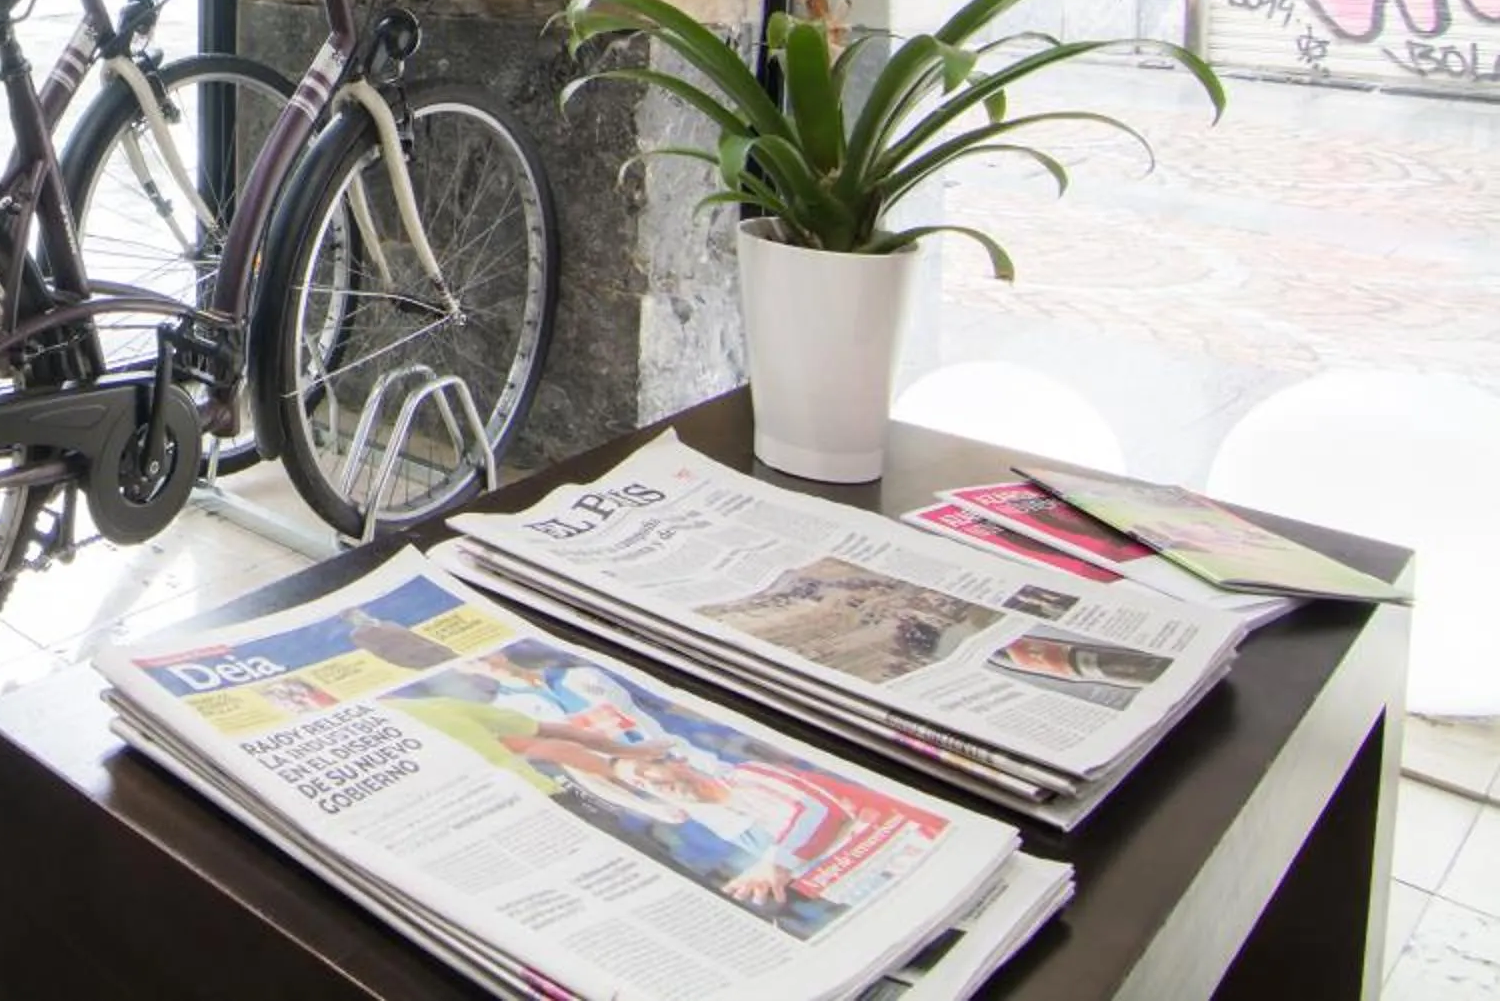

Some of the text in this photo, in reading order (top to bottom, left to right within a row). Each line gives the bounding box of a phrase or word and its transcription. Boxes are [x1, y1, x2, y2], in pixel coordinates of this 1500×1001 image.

[166, 655, 286, 690] Deia
[240, 727, 303, 757] RAJOY
[257, 754, 292, 770] LA
[277, 764, 311, 783] EN
[306, 756, 338, 770] EL
[298, 737, 422, 799] DE SU NUEVO
[317, 759, 420, 814] GOBIERNO
